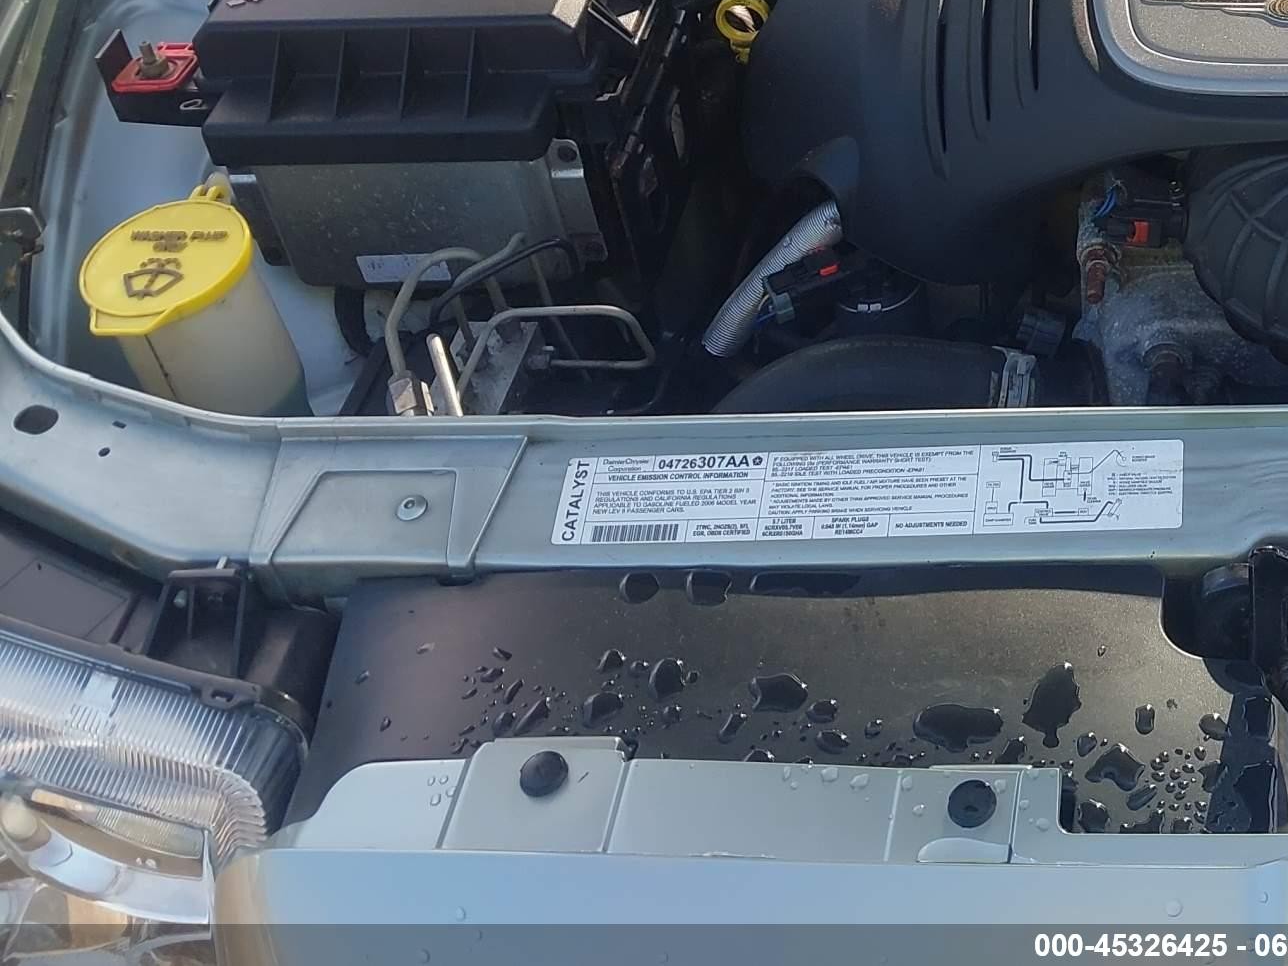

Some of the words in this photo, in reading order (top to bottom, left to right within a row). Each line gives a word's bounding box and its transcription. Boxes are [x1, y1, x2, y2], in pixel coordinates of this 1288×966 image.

[658, 455, 750, 470] 04726307AA
[608, 474, 636, 482] VEHICLE
[637, 473, 668, 481] EMISSION
[669, 472, 701, 480] CONTROL
[703, 471, 749, 479] INFORMATION
[562, 460, 591, 541] CATALYST
